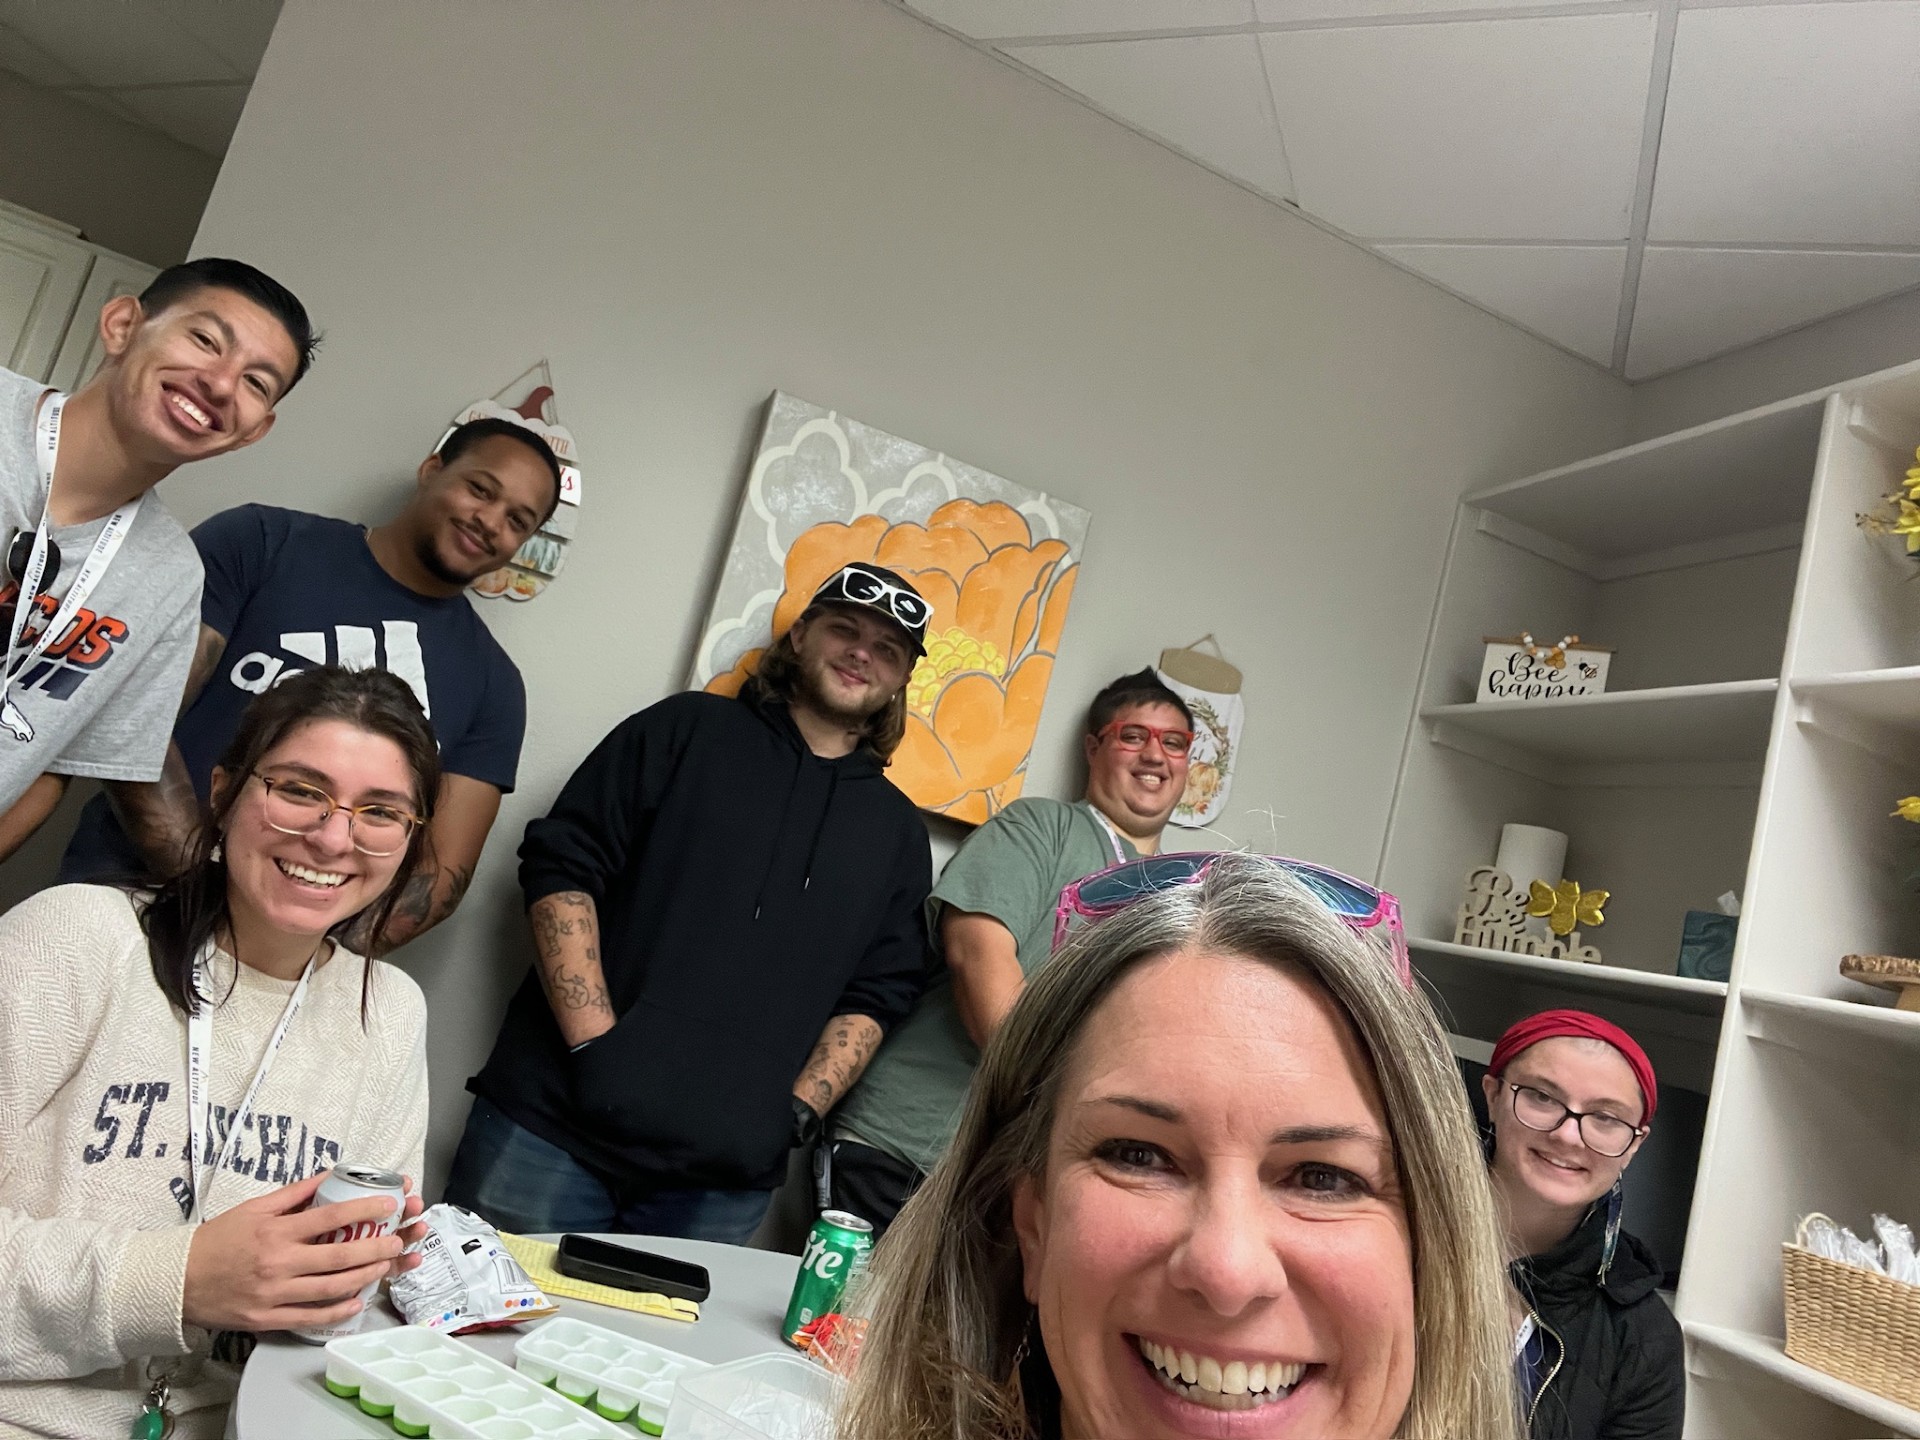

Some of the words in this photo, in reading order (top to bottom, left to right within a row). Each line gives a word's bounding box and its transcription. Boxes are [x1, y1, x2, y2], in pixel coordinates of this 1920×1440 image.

[1505, 652, 1568, 683] Bee
[191, 1046, 200, 1065] NEW
[191, 1067, 200, 1105] ALTITUDE
[83, 1081, 170, 1165] ST.
[424, 1238, 442, 1252] 160
